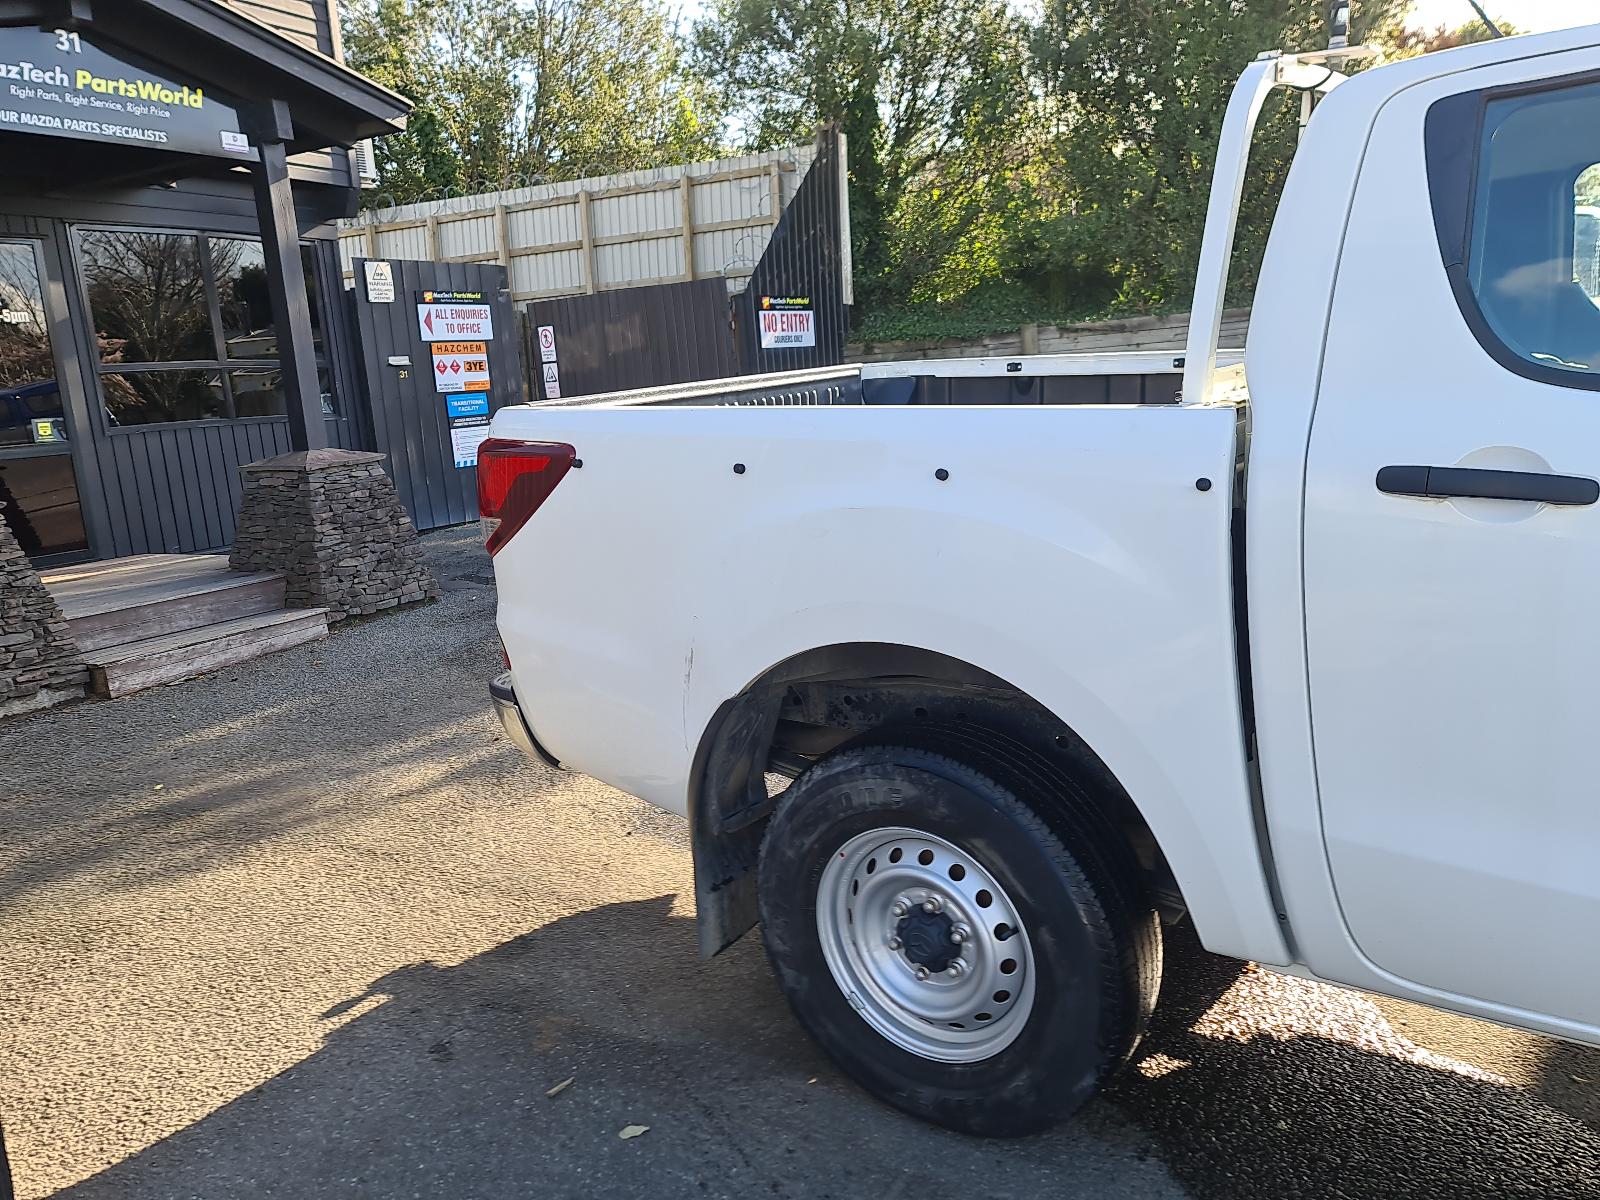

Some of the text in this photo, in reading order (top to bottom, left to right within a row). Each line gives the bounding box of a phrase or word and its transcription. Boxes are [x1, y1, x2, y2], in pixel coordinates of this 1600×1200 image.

[54, 28, 82, 54] 31
[76, 69, 203, 109] PartsWorld
[10, 84, 170, 118] Right Parts, Right Service, Right Price
[0, 109, 168, 143] UR MAZDA PARTS SPECIALISTS
[435, 308, 489, 321] ALL ENQUIRIES
[445, 323, 482, 334] TO OFFICE
[763, 313, 810, 333] NO ENTRY
[436, 344, 482, 353] HAZCHEM
[466, 361, 485, 371] 3YE
[399, 370, 409, 379] 31
